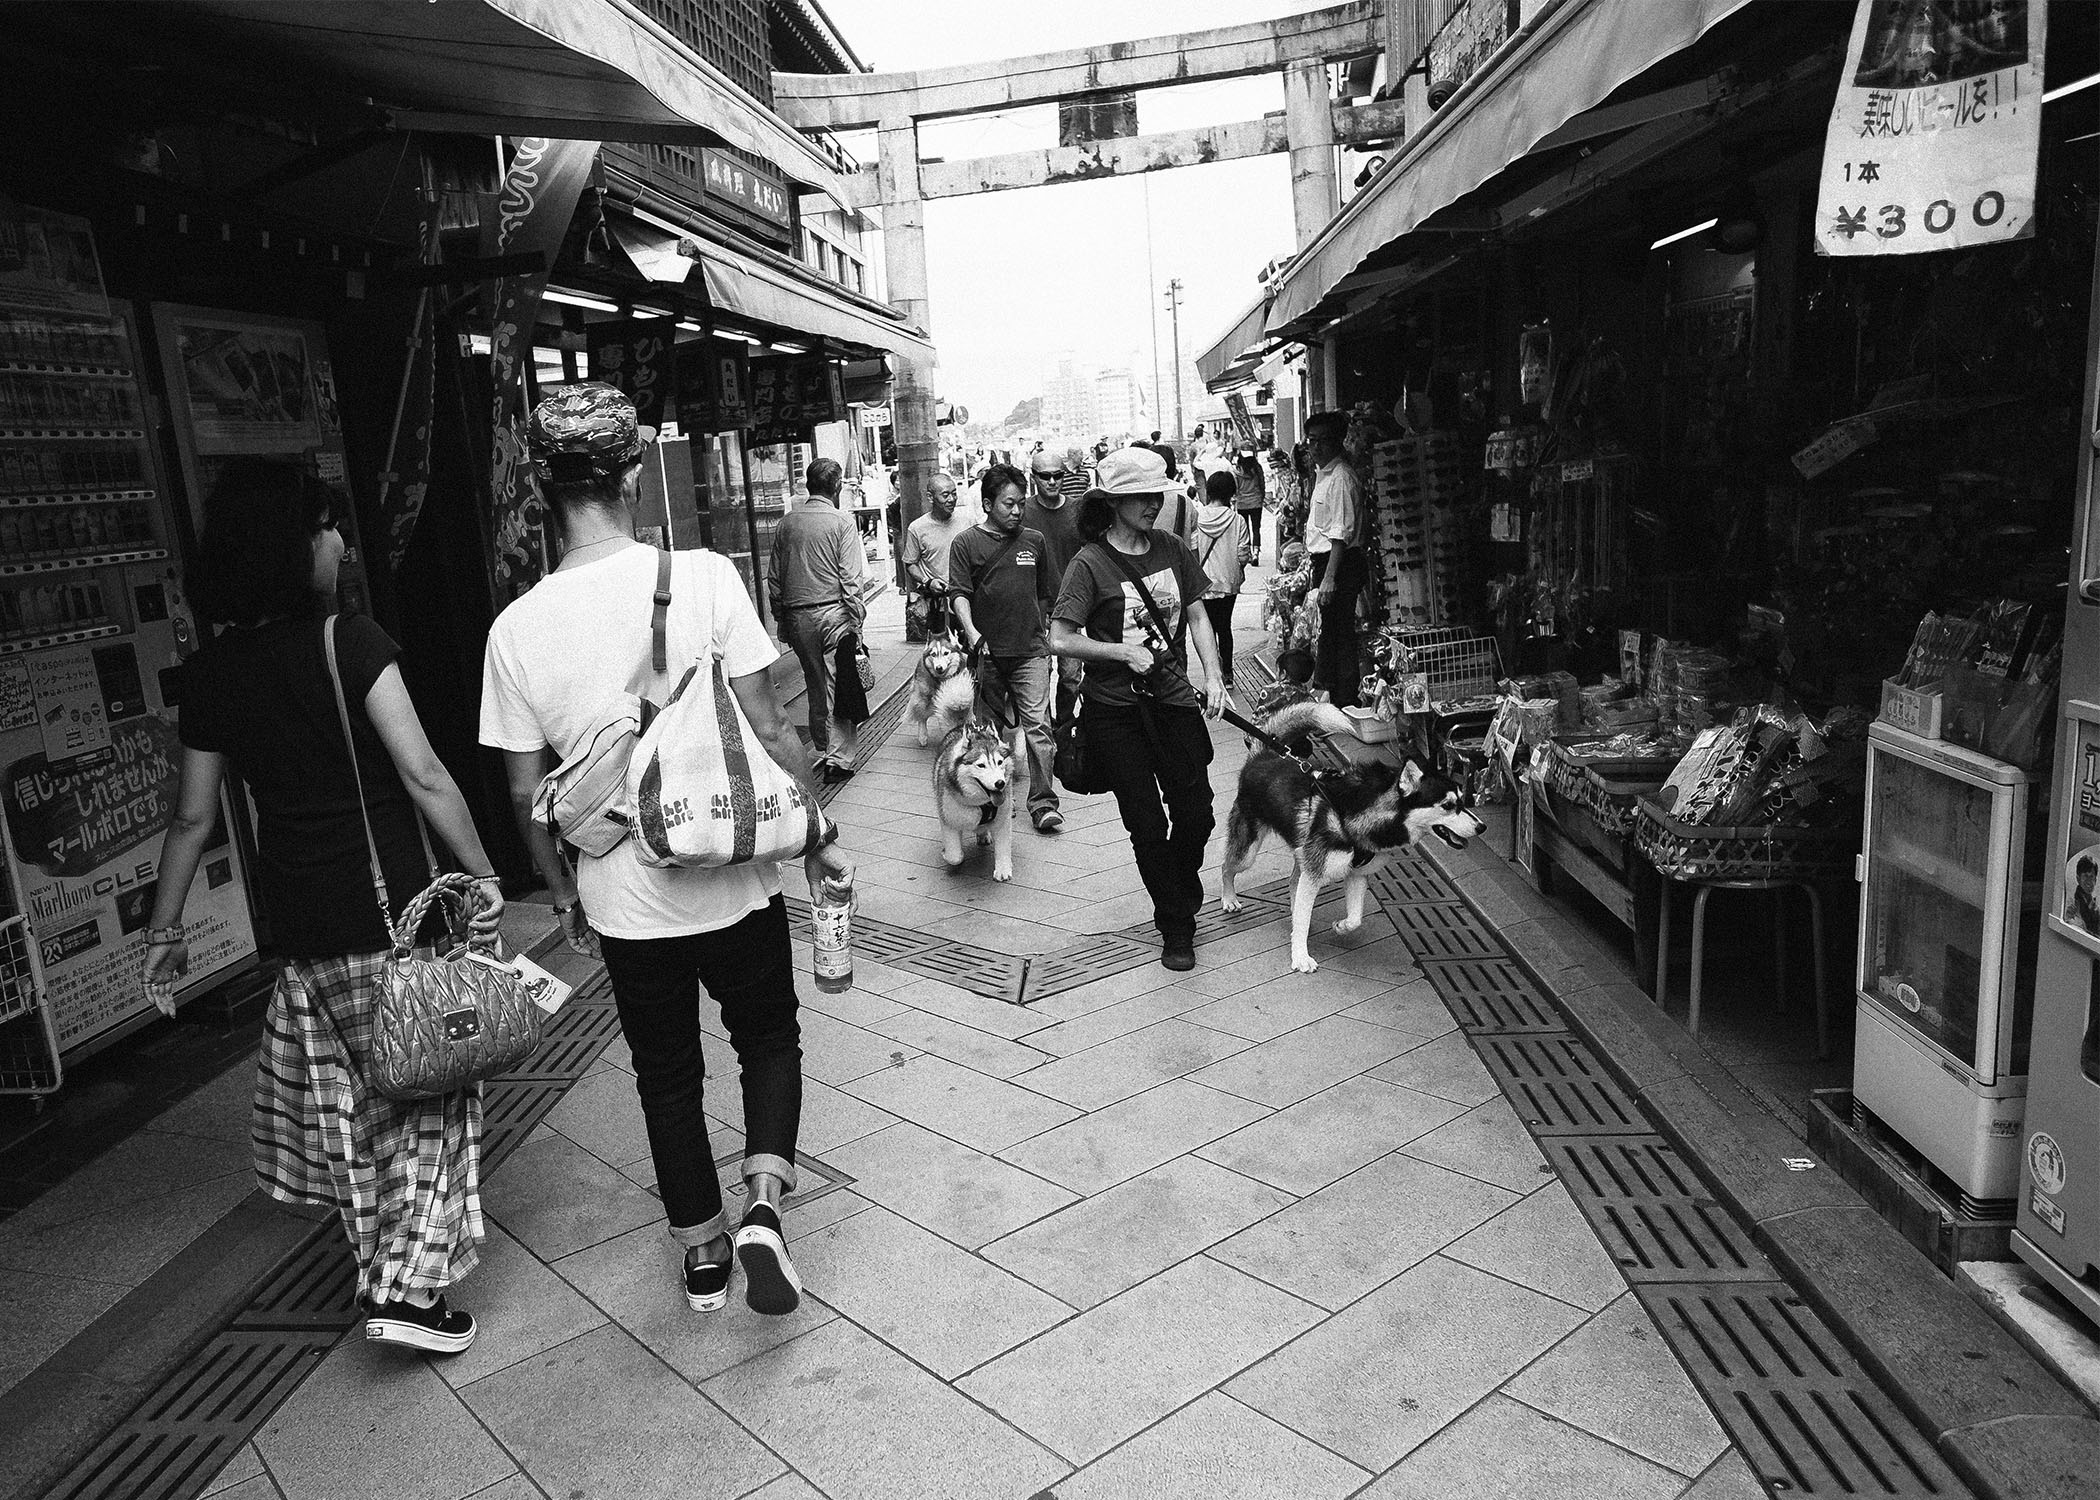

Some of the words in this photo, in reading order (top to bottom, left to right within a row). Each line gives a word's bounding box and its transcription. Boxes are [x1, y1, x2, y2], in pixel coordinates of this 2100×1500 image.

[1843, 160, 1880, 184] 1本
[1836, 191, 2005, 240] ¥300
[664, 810, 694, 829] hore
[29, 884, 52, 898] NEW
[31, 879, 92, 922] Marlboro
[832, 913, 846, 947] 十六茶
